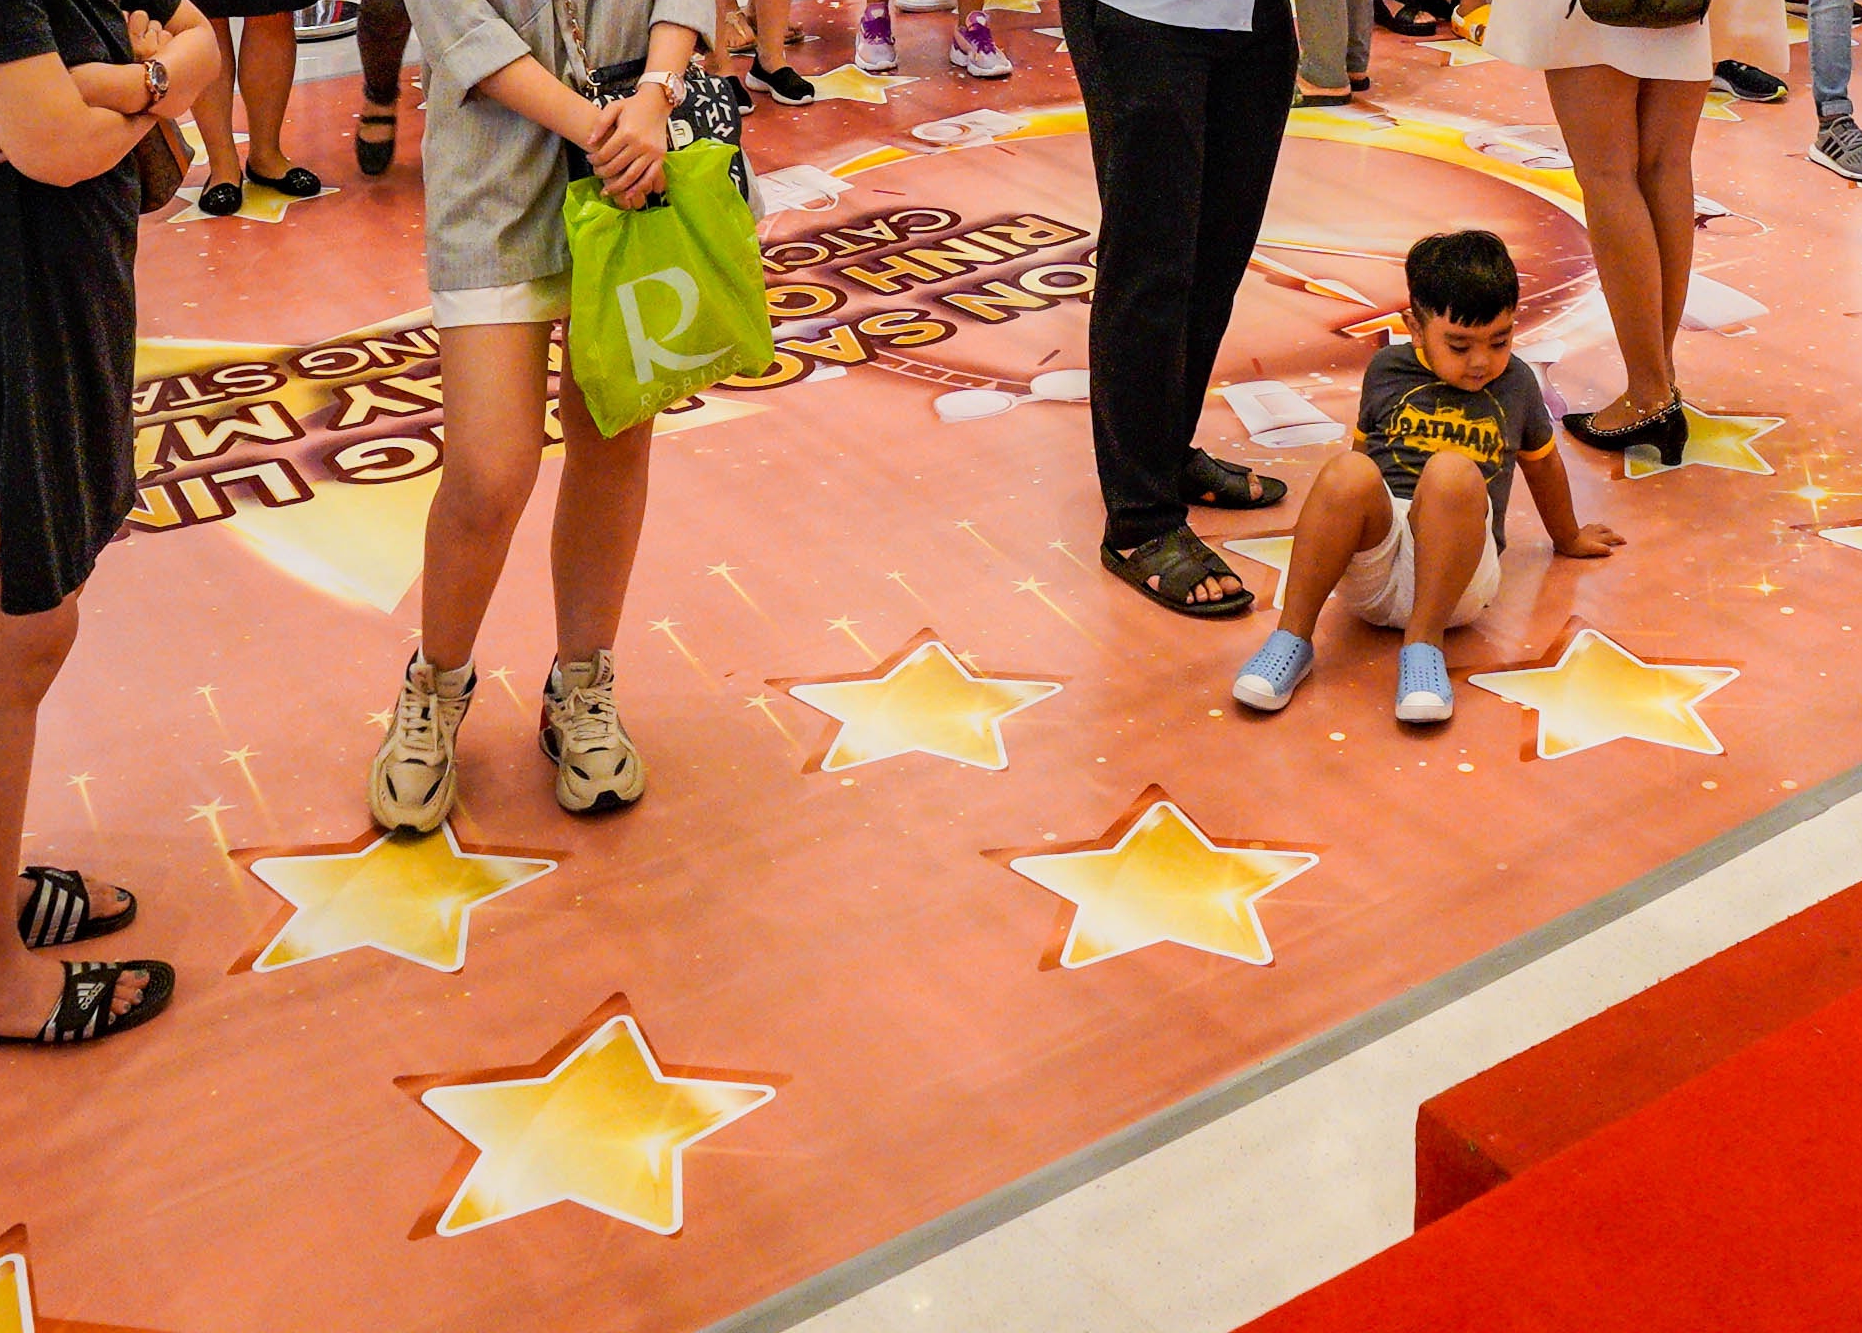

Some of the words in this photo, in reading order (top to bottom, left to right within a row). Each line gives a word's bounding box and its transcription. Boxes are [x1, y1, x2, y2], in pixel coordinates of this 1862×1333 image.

[765, 206, 957, 274] CATC
[840, 215, 1087, 294] RINH
[640, 356, 742, 408] ROBINS
[1400, 417, 1500, 452] BATMAN
